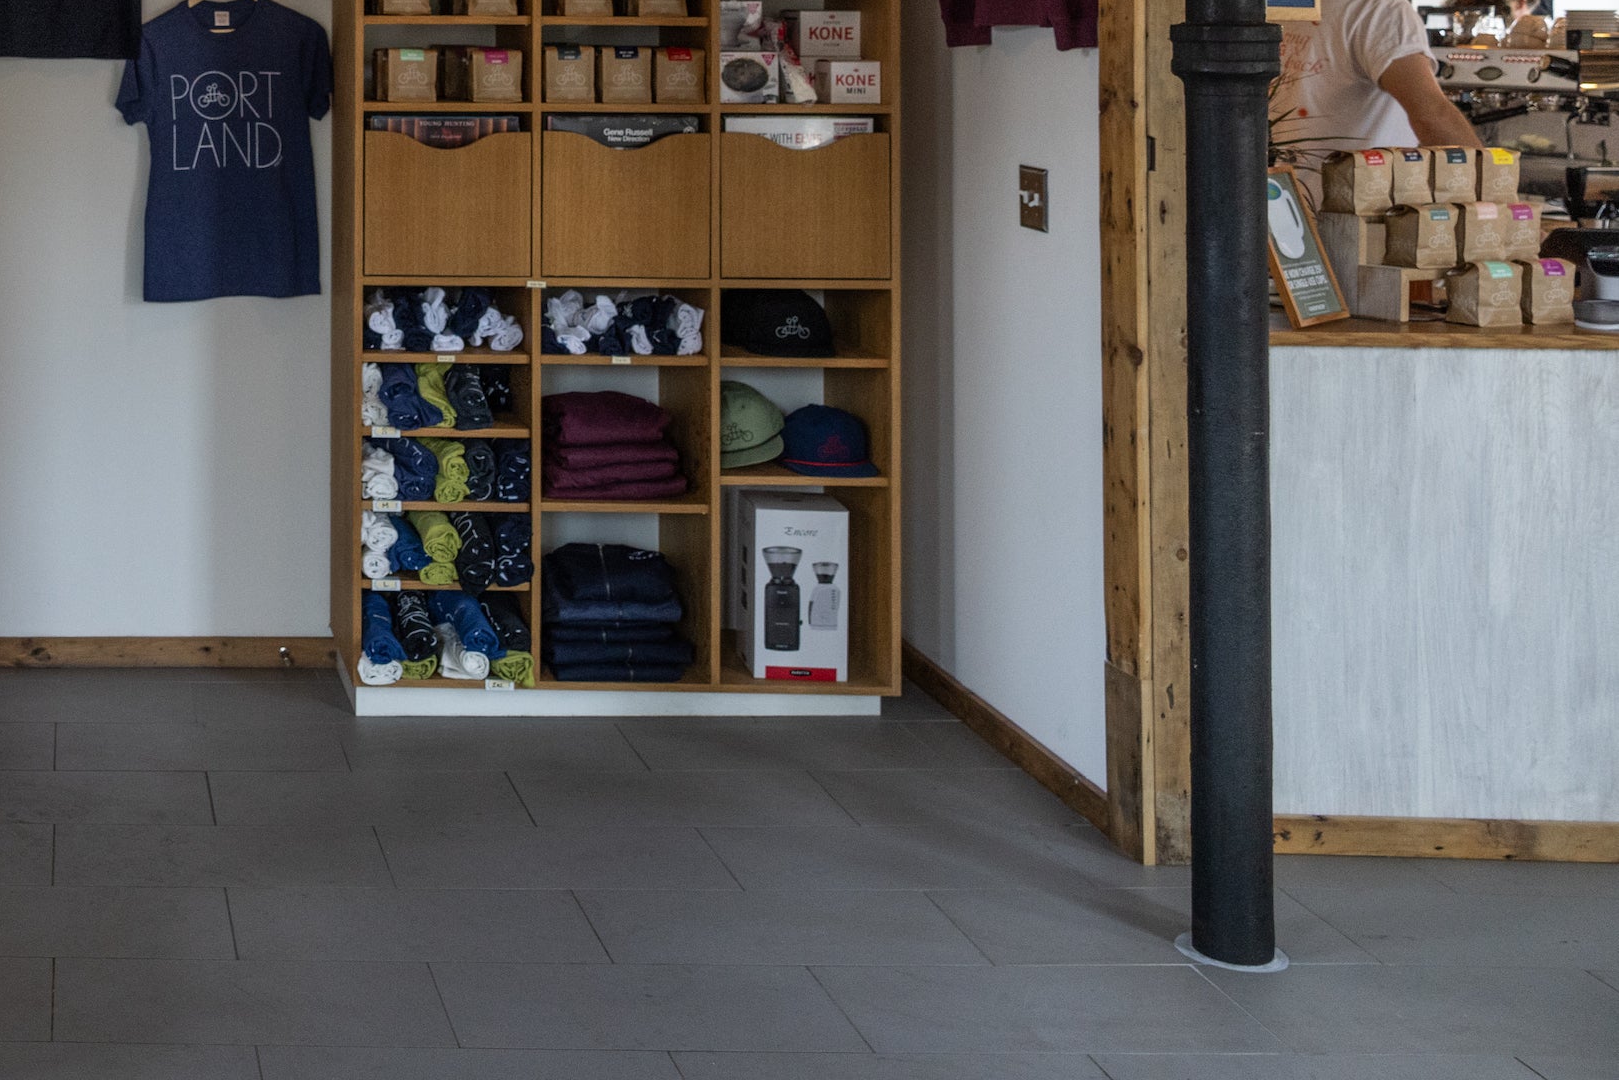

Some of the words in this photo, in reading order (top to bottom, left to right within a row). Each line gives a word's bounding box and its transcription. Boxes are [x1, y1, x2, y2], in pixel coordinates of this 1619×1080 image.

[809, 27, 854, 40] KONE
[836, 75, 876, 86] KONE
[170, 71, 281, 121] PORT
[603, 128, 624, 136] Gene
[625, 128, 653, 136] Russell
[770, 133, 793, 144] WITH
[173, 122, 282, 170] LAND
[784, 527, 818, 537] Encore
